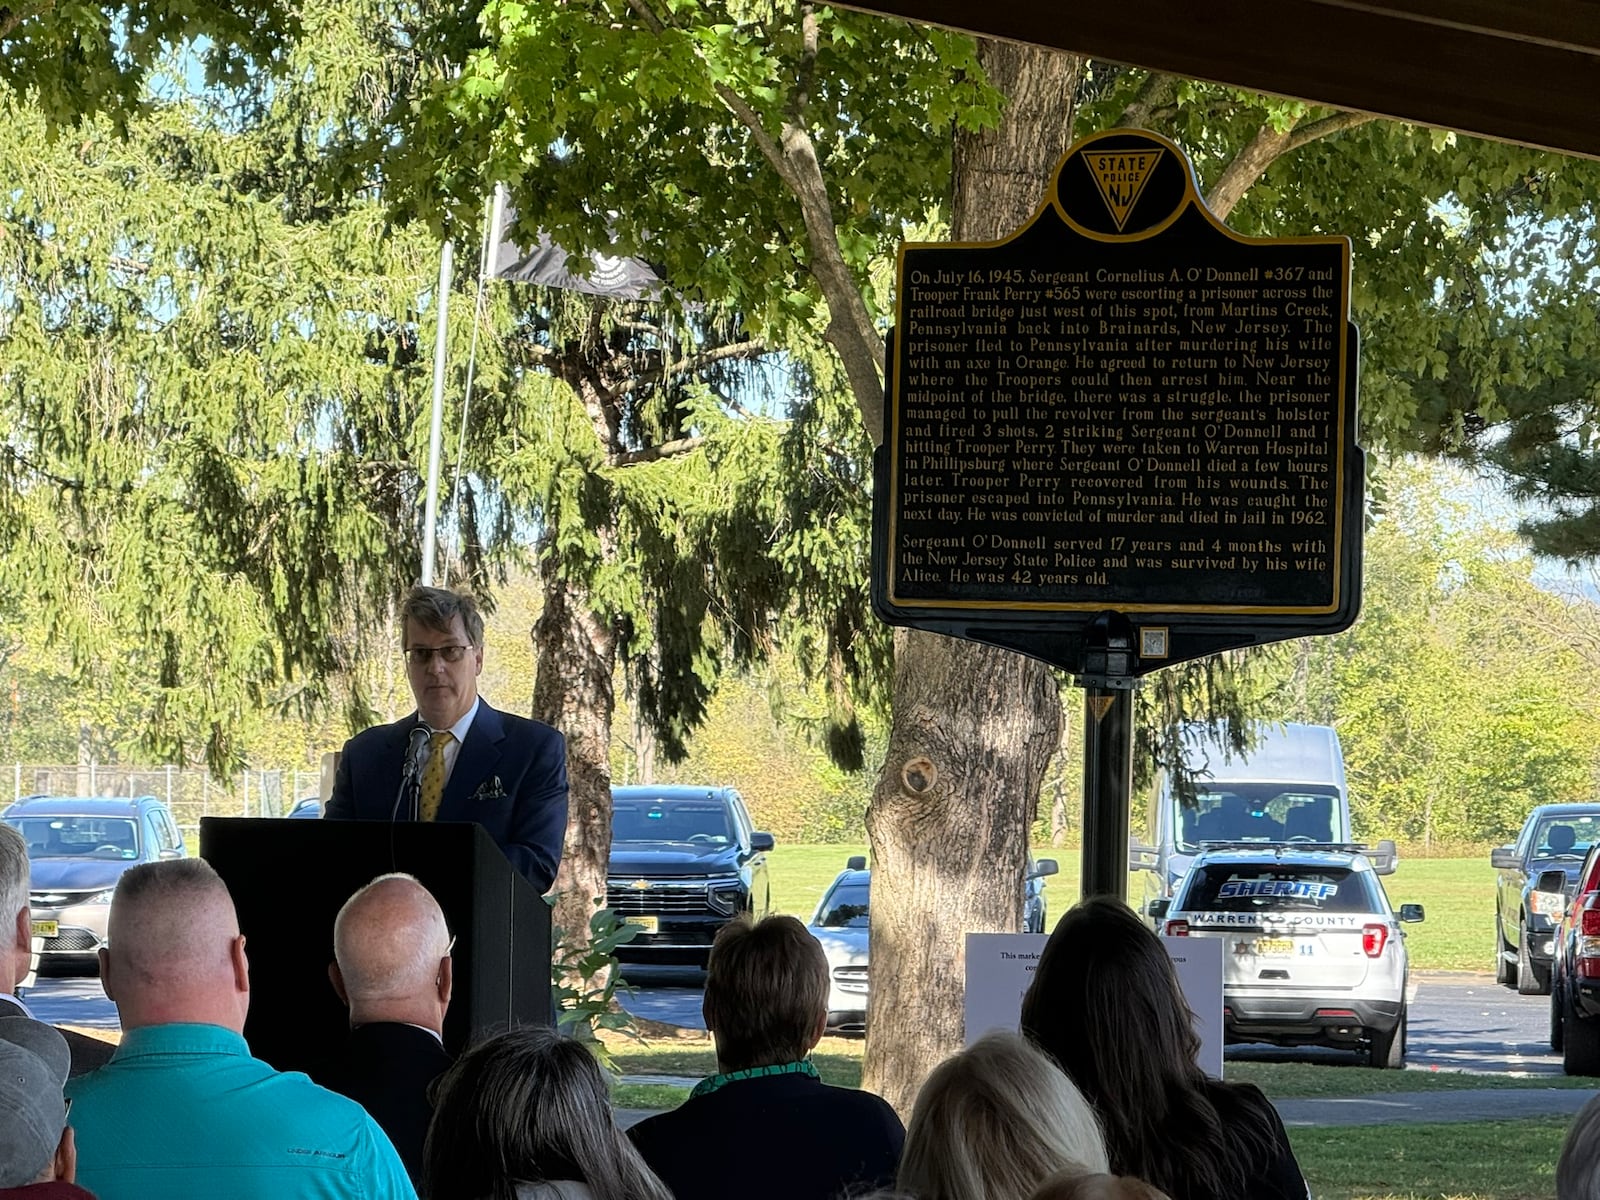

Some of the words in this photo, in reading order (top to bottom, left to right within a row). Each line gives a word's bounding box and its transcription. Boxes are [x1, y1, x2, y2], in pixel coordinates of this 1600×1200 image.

[1098, 156, 1146, 171] STATE
[1103, 172, 1140, 182] POLICE
[1108, 184, 1133, 206] NJ
[910, 270, 930, 284] On
[933, 269, 964, 286] July
[1029, 269, 1089, 285] Sergeant
[1096, 268, 1164, 282] Cornelius
[1264, 267, 1304, 281] #367
[1308, 267, 1332, 280] and
[909, 286, 959, 304] Trooper
[963, 286, 1000, 301] Frank
[1004, 286, 1041, 303] Perry
[1045, 285, 1080, 300] #565
[1085, 289, 1116, 300] were
[1121, 286, 1184, 305] escorting
[1201, 285, 1258, 304] prisoner
[1262, 288, 1306, 298] across
[1312, 284, 1332, 298] the
[910, 304, 965, 318] railroad
[971, 304, 1014, 322] bridge
[1053, 305, 1084, 317] west
[1090, 303, 1102, 317] of
[1110, 303, 1136, 317] this
[1184, 303, 1214, 317] from
[1221, 302, 1277, 316] Martins
[909, 320, 1006, 338] Pennsylvania
[1017, 320, 1050, 334] back
[1060, 320, 1089, 334] into
[1191, 319, 1226, 334] New
[1303, 319, 1332, 333] The
[908, 339, 968, 355] prisoner
[975, 338, 1002, 352] fled
[1010, 339, 1022, 352] to
[1030, 337, 1128, 356] Pennsylvania
[1135, 337, 1172, 351] after
[1179, 337, 1256, 356] murdering
[1265, 337, 1288, 350] his
[1298, 336, 1331, 350] wife
[909, 355, 939, 369] with
[945, 359, 960, 369] an
[966, 359, 990, 369] axe
[997, 355, 1009, 369] in
[1075, 354, 1094, 368] He
[1100, 355, 1145, 374] agreed
[1153, 356, 1165, 368] to
[1172, 356, 1217, 368] return
[1224, 356, 1236, 368] to
[1242, 354, 1274, 368] New
[1280, 354, 1329, 374] Jersey
[908, 372, 953, 386] where
[965, 372, 987, 385] the
[996, 371, 1061, 391] Troopers
[1071, 372, 1109, 386] could
[1120, 371, 1152, 386] then
[1161, 373, 1207, 385] arrest
[1256, 371, 1295, 385] Near
[1307, 371, 1330, 385] the
[907, 389, 964, 405] midpoint
[971, 389, 983, 403] of
[991, 389, 1012, 403] the
[1074, 389, 1111, 403] there
[1118, 392, 1146, 403] was
[1239, 389, 1261, 403] the
[1269, 389, 1330, 405] prisoner
[906, 406, 965, 422] managed
[973, 408, 985, 419] to
[992, 406, 1018, 423] pull
[1026, 406, 1047, 419] the
[1055, 406, 1114, 420] revolver
[1122, 407, 1153, 420] from
[1162, 406, 1183, 420] the
[1191, 408, 1265, 426] sergeant's
[1276, 407, 1329, 421] holster
[905, 423, 931, 437] and
[939, 423, 974, 437] fired
[982, 423, 991, 437] 3
[1045, 424, 1054, 438] 2
[1063, 424, 1122, 443] striking
[1131, 423, 1196, 443] Sergeant
[1290, 424, 1315, 438] and
[905, 439, 950, 458] hitting
[955, 439, 1010, 459] Trooper
[1060, 440, 1095, 459] They
[1102, 443, 1135, 454] were
[1142, 440, 1180, 454] taken
[1187, 442, 1199, 455] to
[1204, 440, 1259, 455] Warren
[1266, 440, 1327, 458] Hospital
[905, 455, 918, 469] in
[922, 456, 1005, 475] Phillipsburg
[1011, 456, 1053, 470] where
[1059, 456, 1120, 473] Sergeant
[1207, 458, 1236, 472] died
[1255, 458, 1279, 472] few
[1287, 458, 1328, 472] hours
[951, 472, 1009, 490] Trooper
[1019, 473, 1060, 491] Perry
[1071, 474, 1142, 488] recovered
[1154, 475, 1186, 488] from
[1197, 475, 1220, 489] his
[1298, 474, 1328, 490] The
[903, 490, 965, 506] prisoner
[971, 491, 1029, 509] escaped
[1038, 491, 1064, 504] into
[1181, 491, 1201, 506] He
[1210, 495, 1238, 506] was
[1247, 492, 1296, 509] caught
[1305, 493, 1327, 507] the
[903, 507, 932, 520] next
[968, 507, 985, 520] He
[991, 511, 1017, 521] was
[1022, 508, 1083, 522] convicted
[1087, 508, 1100, 522] of
[1106, 509, 1155, 523] murder
[1160, 509, 1184, 523] and
[1189, 510, 1218, 524] died
[1224, 510, 1236, 524] in
[1272, 510, 1284, 524] in
[902, 533, 965, 554] Sergeant
[1053, 536, 1102, 550] served
[1110, 535, 1125, 551] 17
[1130, 540, 1171, 554] years
[1179, 538, 1204, 551] and
[1211, 538, 1221, 552] 4
[1228, 539, 1281, 552] months
[1291, 539, 1326, 553] with
[902, 551, 922, 564] the
[928, 551, 957, 565] New
[962, 552, 1007, 569] Jersey
[1013, 552, 1048, 567] State
[1055, 553, 1095, 567] Police
[1103, 554, 1127, 568] and
[1135, 558, 1162, 568] was
[1171, 555, 1235, 569] survived
[1242, 556, 1259, 573] by
[1265, 556, 1287, 570] his
[1294, 556, 1326, 571] wife
[950, 568, 969, 582] He
[976, 572, 1004, 583] was
[1011, 569, 1031, 583] 42
[1039, 573, 1078, 589] years
[1218, 880, 1338, 900] SHERIFF
[1193, 914, 1257, 924] WARREN
[1294, 915, 1356, 925] COUNTY
[1000, 952, 1016, 960] This
[1018, 952, 1041, 960] marke
[1299, 945, 1314, 956] 11
